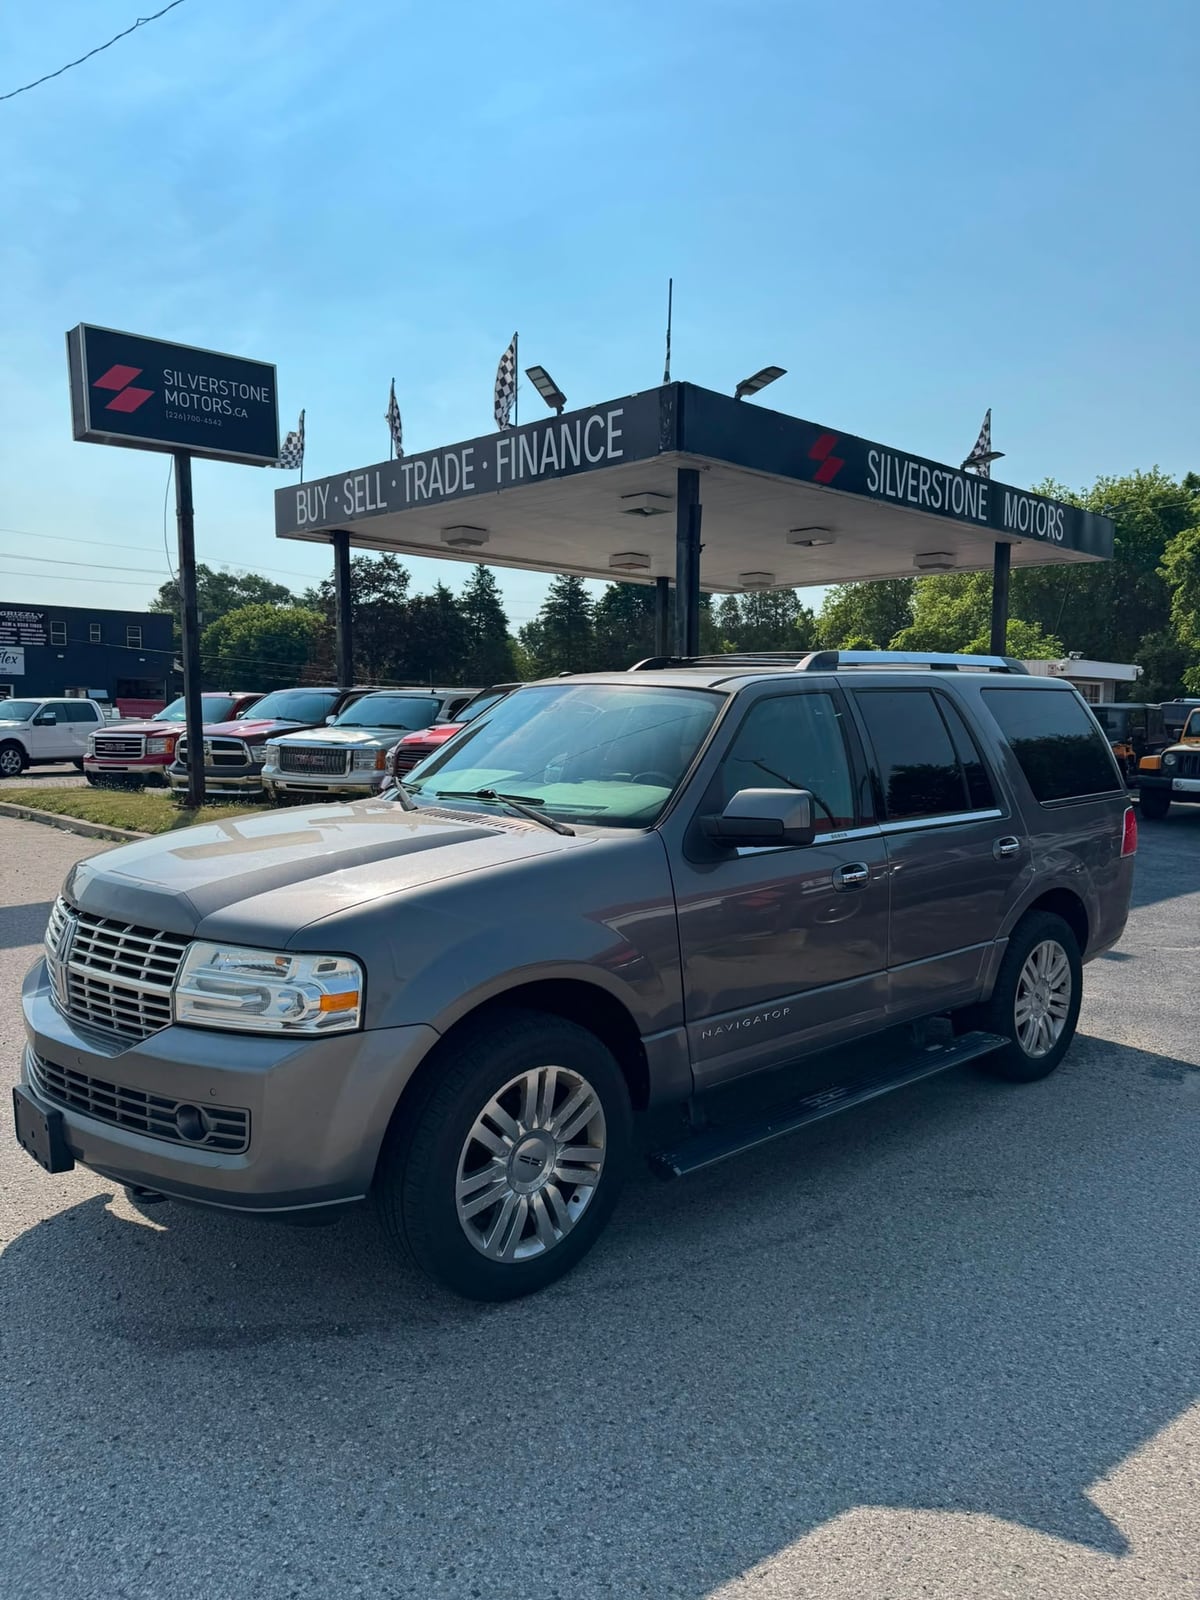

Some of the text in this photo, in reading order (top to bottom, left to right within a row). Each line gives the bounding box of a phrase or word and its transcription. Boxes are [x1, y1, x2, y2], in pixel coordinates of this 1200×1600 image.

[163, 368, 270, 403] SILVERSTONE
[165, 389, 248, 418] MOTORS.CA
[296, 408, 624, 524] BUY SELL TRADE FINANCE
[866, 449, 1065, 541] SILVERSTONE MOTORS
[701, 1007, 791, 1039] NAVIGATOR
